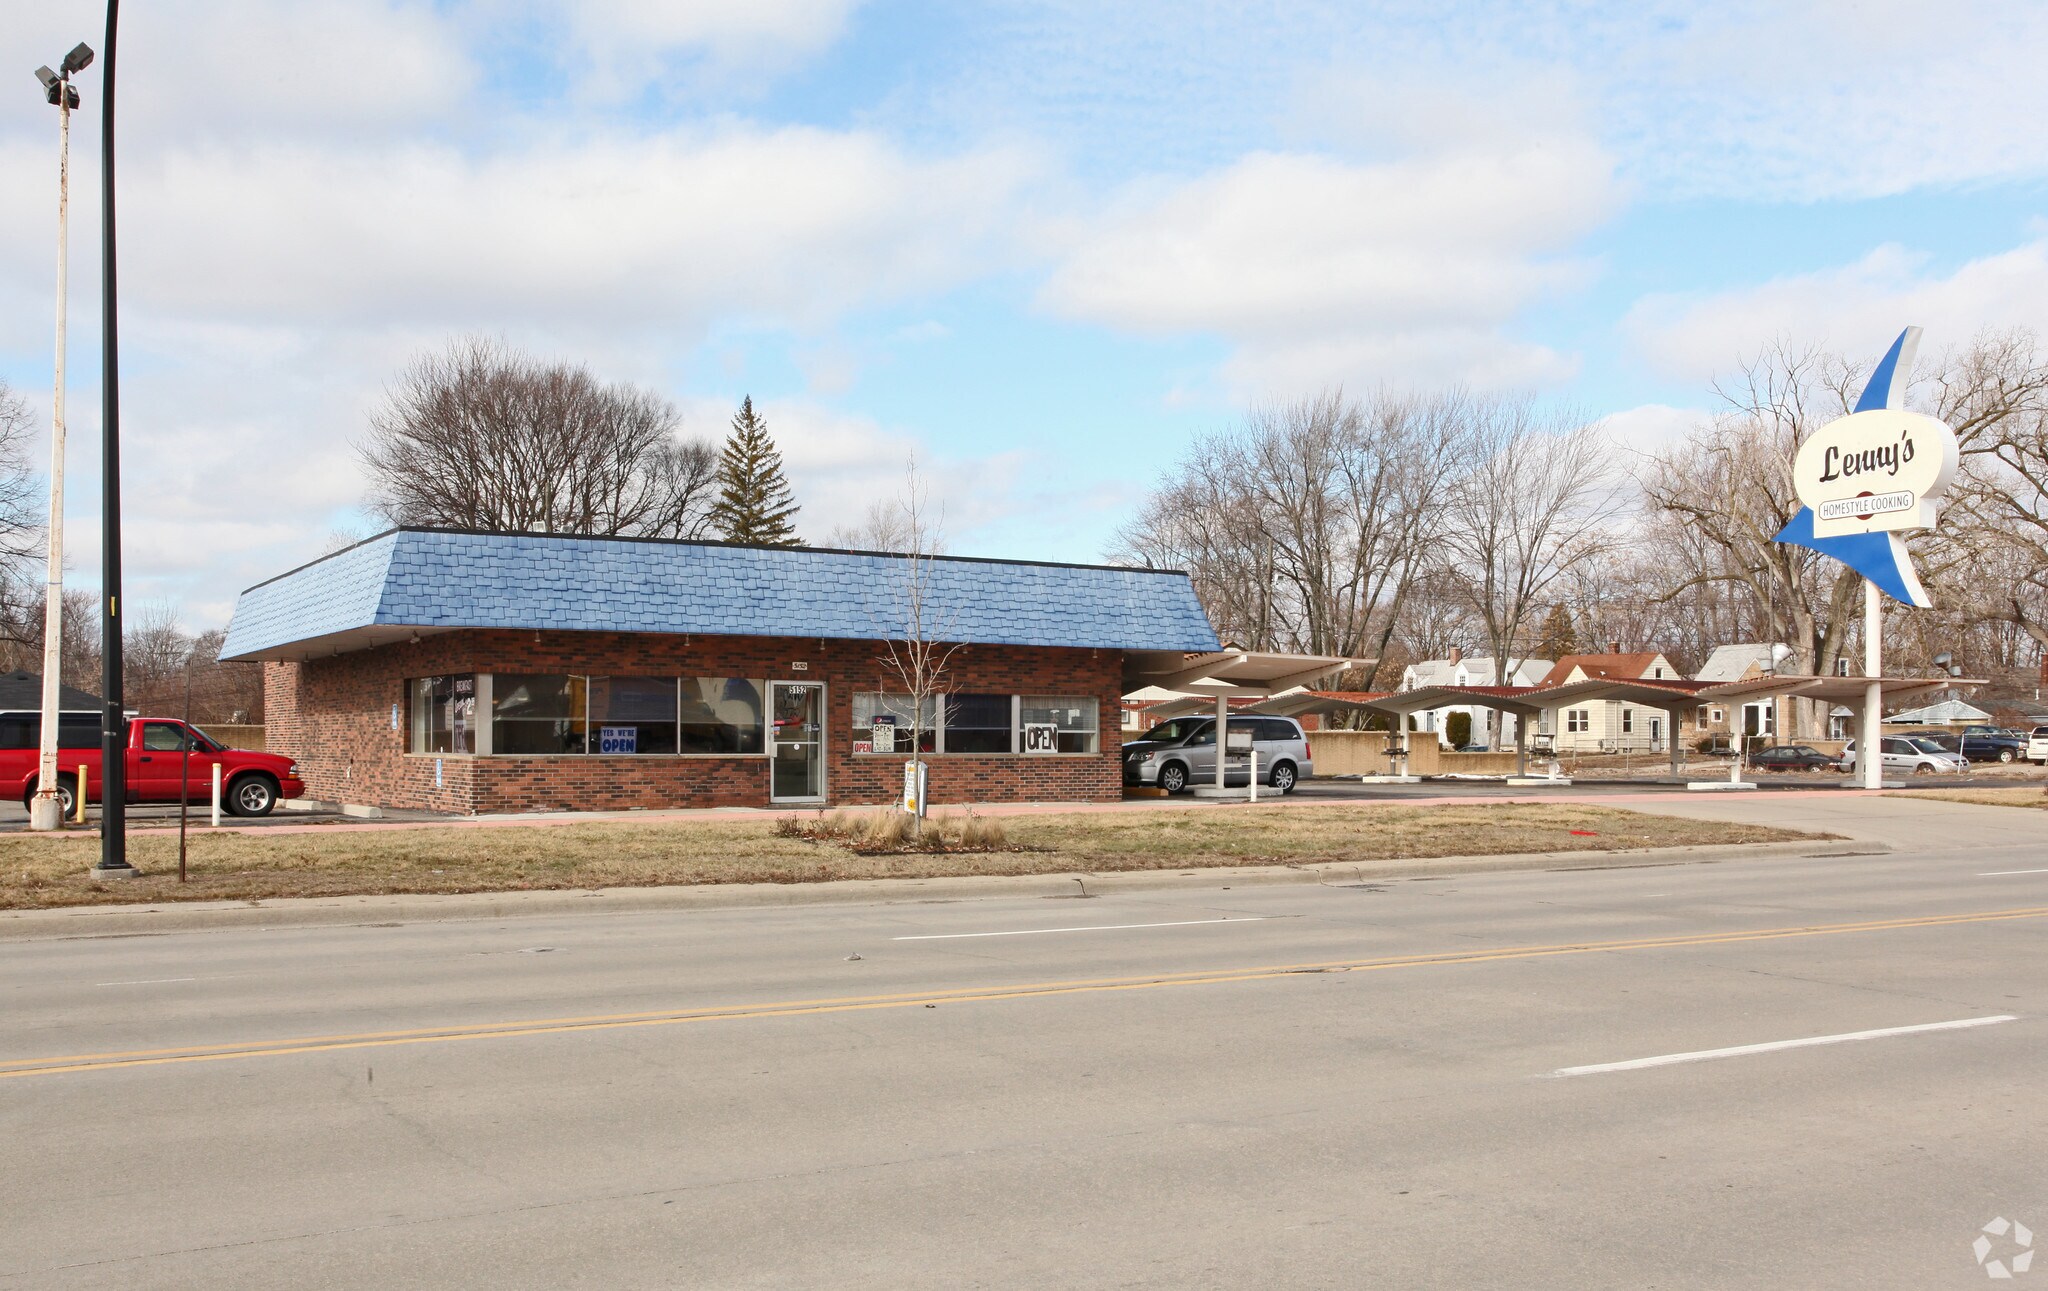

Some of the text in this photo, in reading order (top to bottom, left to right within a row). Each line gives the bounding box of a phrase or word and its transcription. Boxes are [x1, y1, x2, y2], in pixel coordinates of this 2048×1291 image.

[1819, 430, 1914, 482] Lenny's
[1823, 494, 1909, 516] HOMESTYLE COOKING
[789, 685, 806, 694] 5152
[602, 729, 635, 737] YES WE'RE
[1027, 726, 1058, 750] OPEN
[602, 738, 635, 752] OPEN
[854, 742, 873, 753] OPEN
